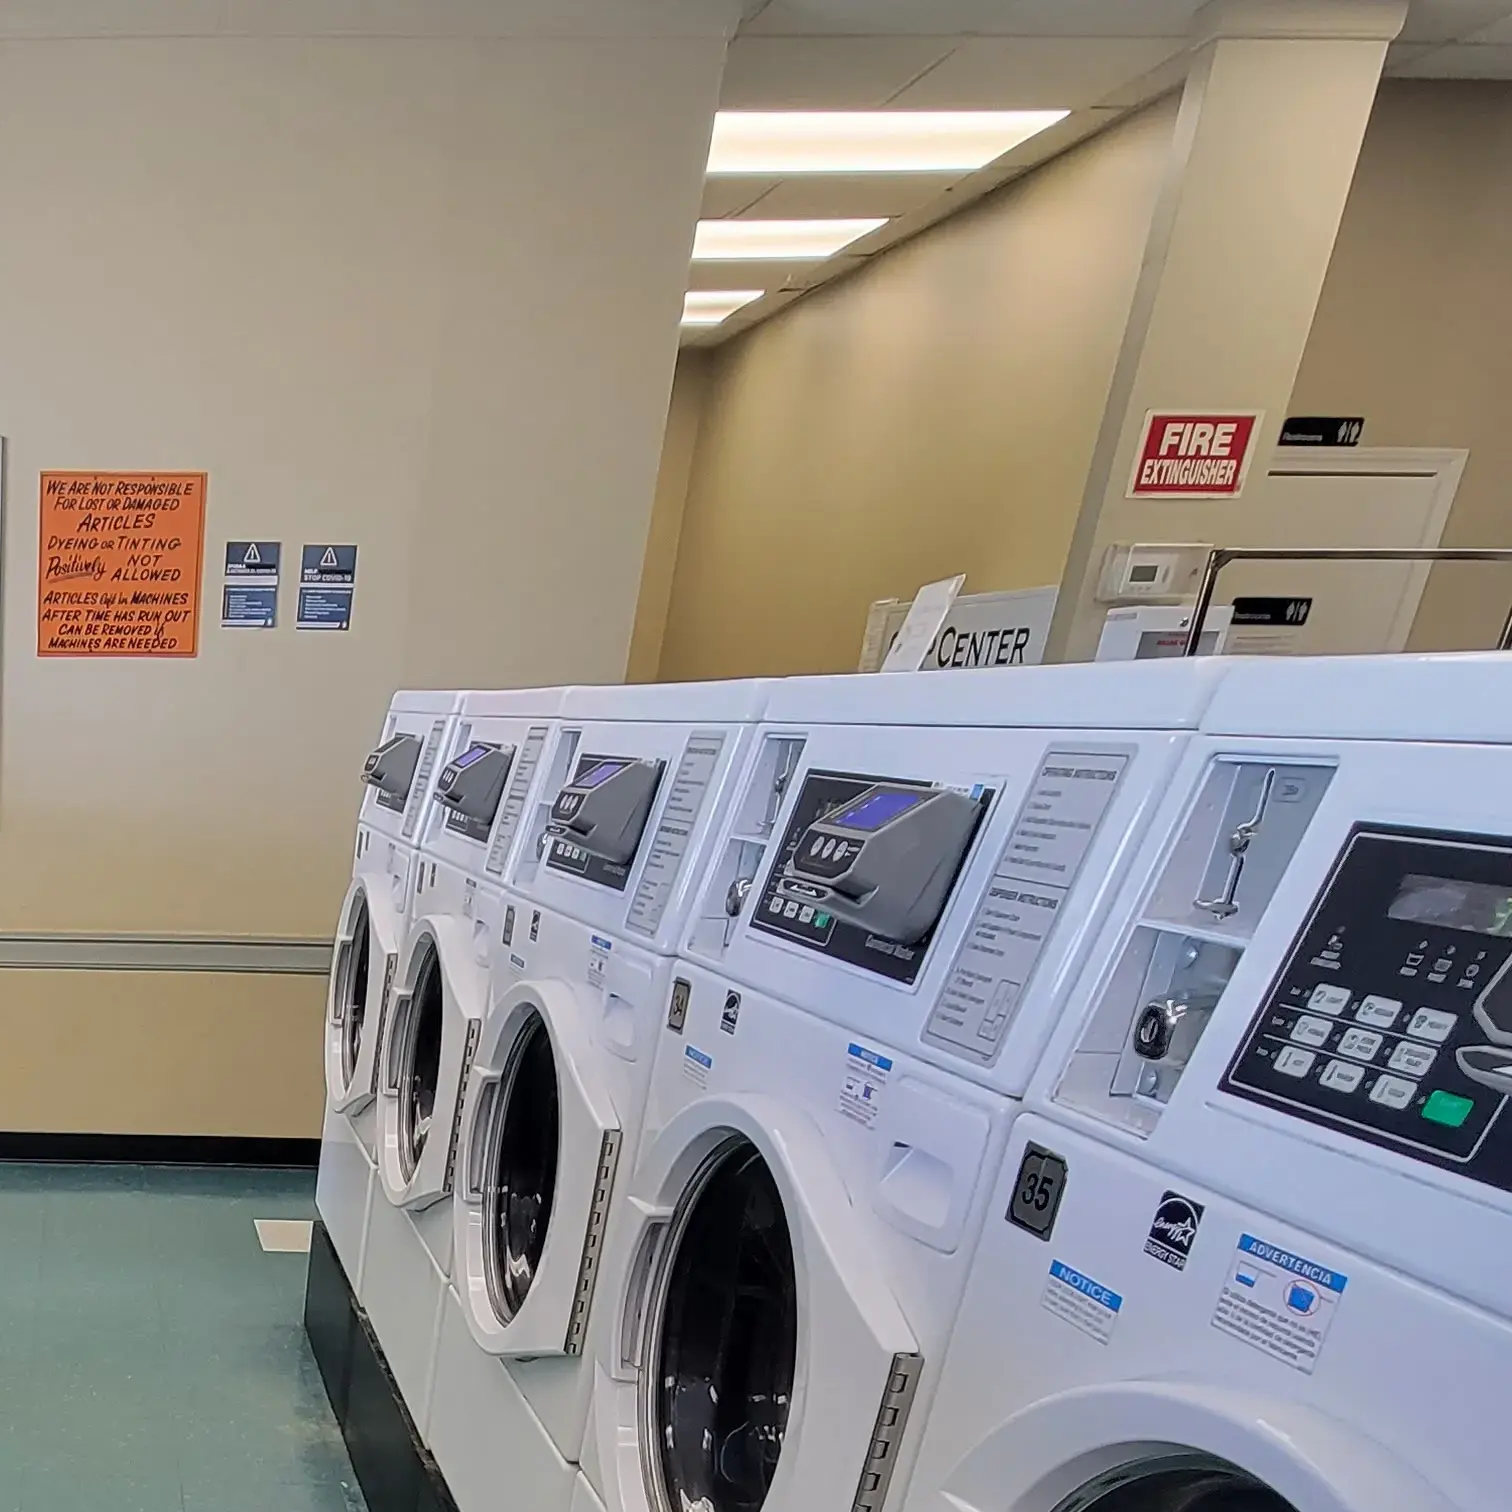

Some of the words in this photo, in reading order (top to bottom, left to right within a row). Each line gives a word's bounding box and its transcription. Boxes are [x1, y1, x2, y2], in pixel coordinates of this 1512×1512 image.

[1158, 422, 1238, 456] FIRE
[1140, 459, 1238, 486] EXTINGUISHER
[46, 480, 67, 495] WE
[67, 481, 89, 495] ARE
[92, 482, 114, 495] NOT
[115, 481, 194, 495] RESPONSIBLE
[54, 497, 77, 511] FOR
[78, 497, 105, 511] LOST
[106, 498, 123, 511] OR
[123, 497, 180, 511] DAMAGED
[77, 513, 156, 533] ARTICLES
[48, 536, 99, 550] DYEING
[117, 536, 182, 550] TINTING
[45, 553, 107, 582] Positively
[128, 554, 163, 567] NOT
[111, 568, 181, 582] ALLOWED
[43, 590, 98, 604] ARTICLES
[130, 591, 189, 605] MACHINES
[42, 609, 82, 622] AFTER
[84, 609, 111, 622] TIME
[113, 610, 136, 622] HAS
[137, 610, 161, 622] RUN
[164, 609, 191, 622] OUT
[58, 624, 82, 636] CAN
[84, 624, 97, 636] BE
[100, 624, 152, 636] REMOVED
[48, 637, 102, 649] MACHINES
[104, 637, 125, 649] ARE
[127, 637, 178, 649] NEEDED
[938, 626, 1030, 668] CENTER
[1022, 1173, 1054, 1211] 35
[1144, 1241, 1169, 1260] ENERGY
[1168, 1253, 1185, 1268] STAR
[1249, 1241, 1332, 1285] ADVERTENCIA
[1059, 1267, 1113, 1306] NOTICE
